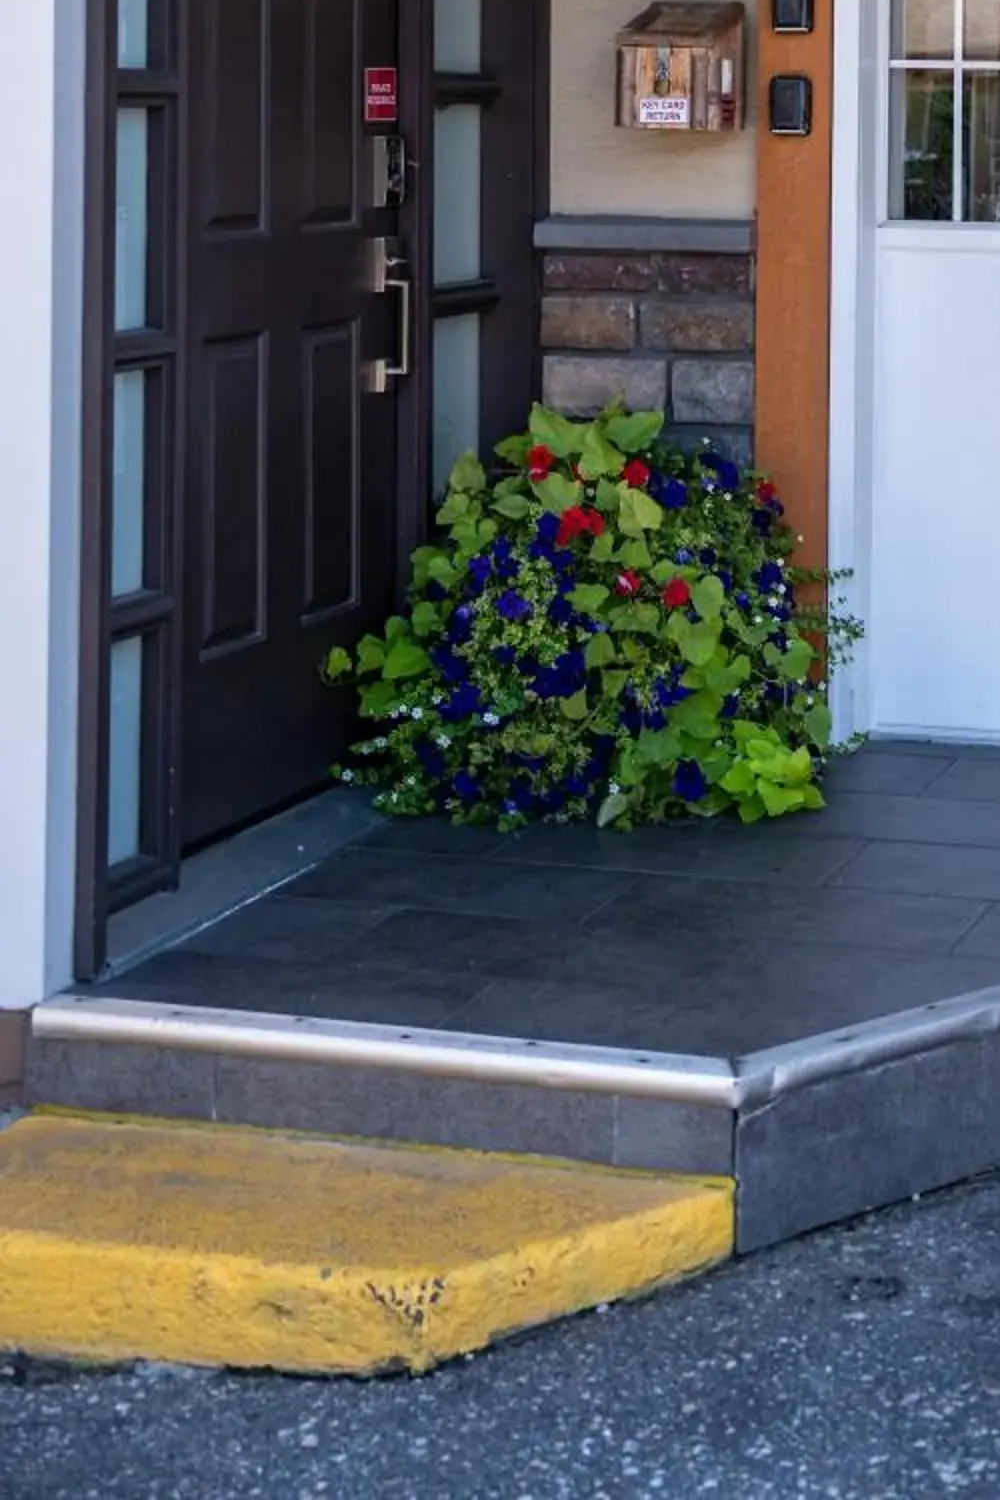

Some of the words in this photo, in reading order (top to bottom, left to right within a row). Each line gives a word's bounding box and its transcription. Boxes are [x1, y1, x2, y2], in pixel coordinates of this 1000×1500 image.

[641, 101, 659, 110] KEY
[661, 101, 685, 110] CARD
[645, 111, 681, 121] RETURN
